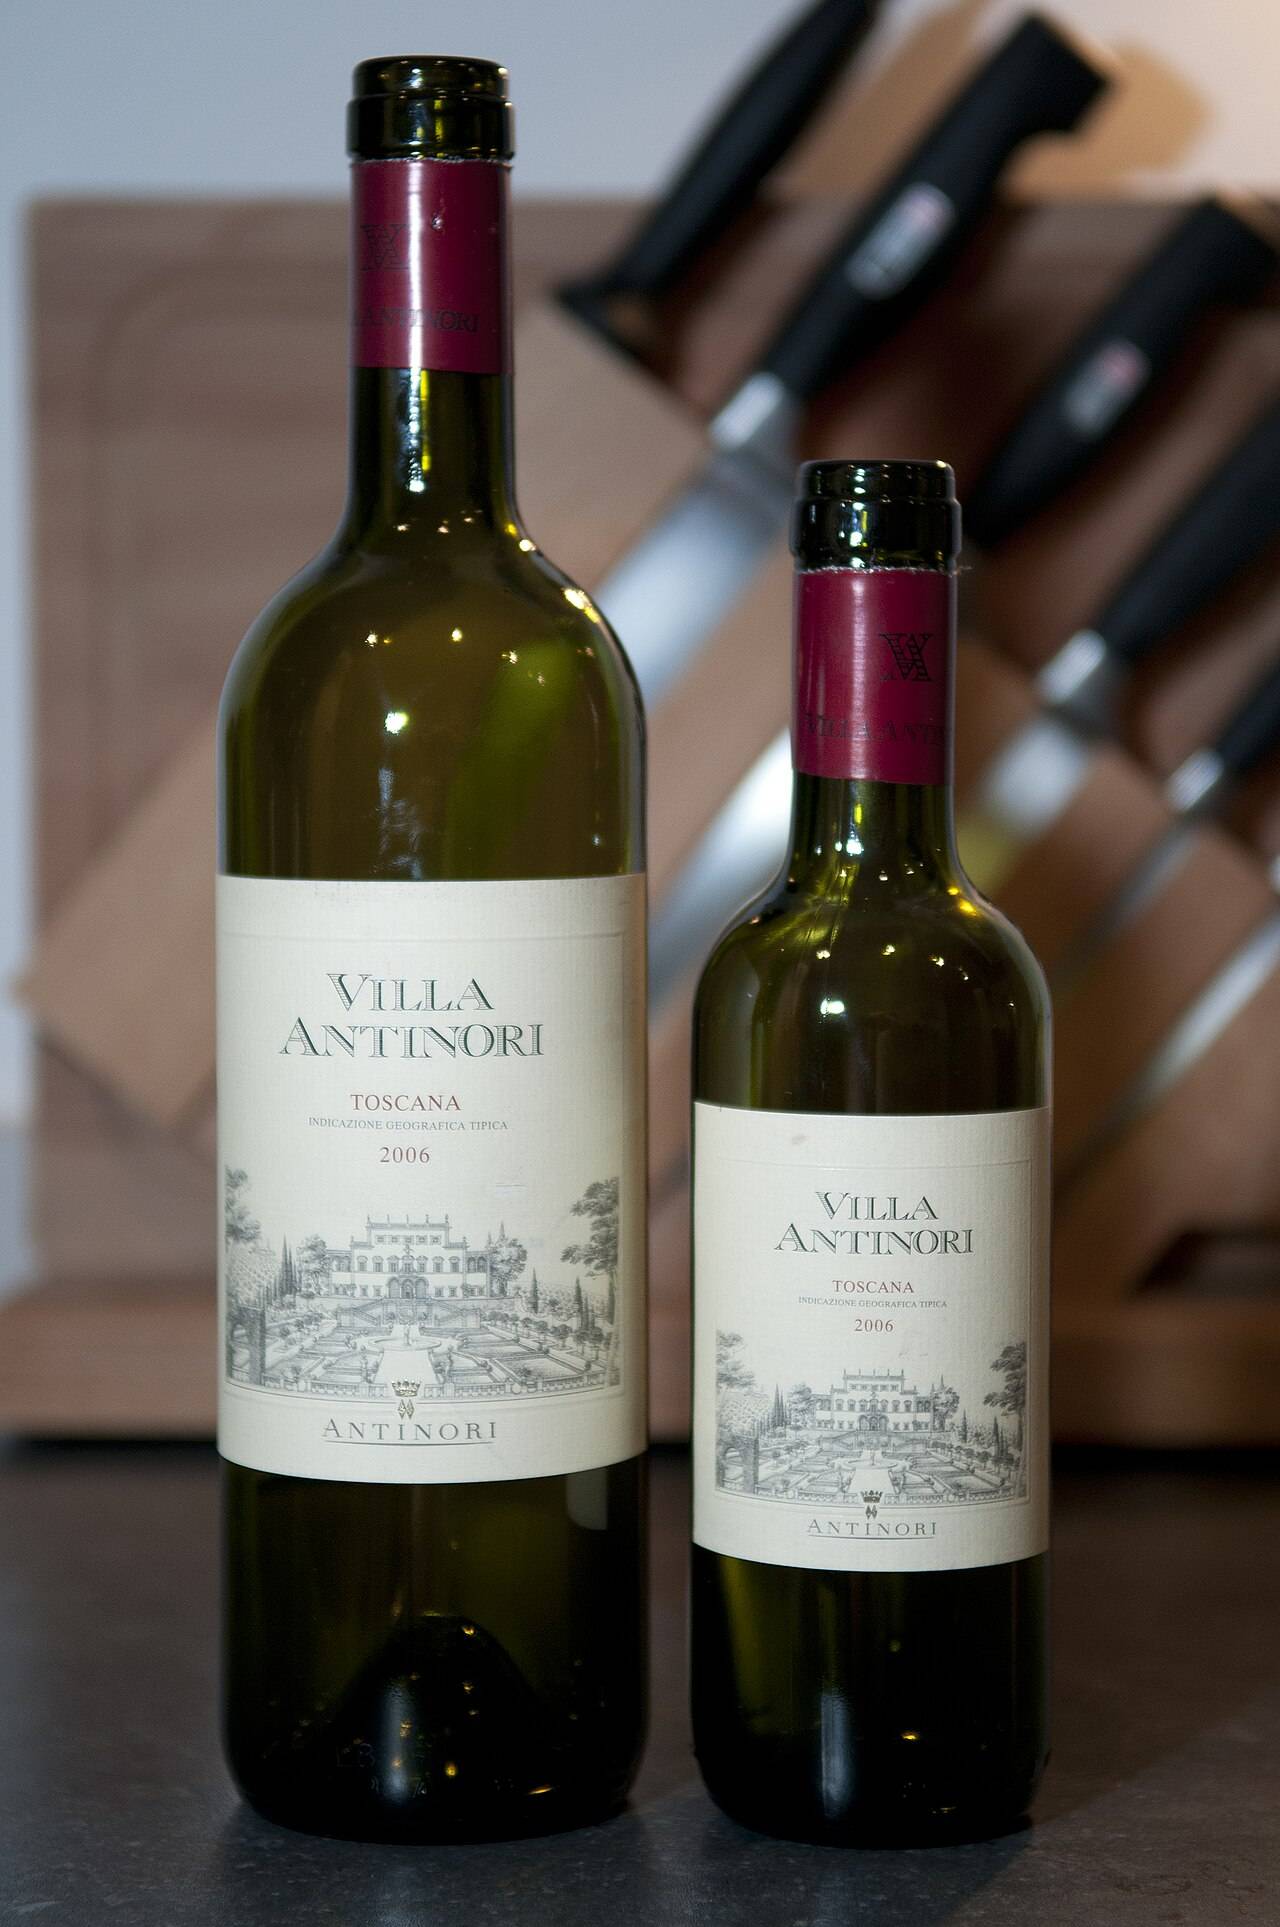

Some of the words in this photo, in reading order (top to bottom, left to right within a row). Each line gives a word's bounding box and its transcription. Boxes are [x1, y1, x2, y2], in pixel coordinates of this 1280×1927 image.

[327, 973, 494, 1011] VILLA
[279, 1016, 544, 1058] ANTINORI
[350, 1094, 461, 1111] TOSCANA
[309, 1117, 383, 1130] INDICAZIONE
[385, 1120, 466, 1131] GEOGRAFICA
[469, 1120, 508, 1130] TIPICA
[379, 1146, 430, 1163] 2006
[816, 1191, 939, 1220] VILLA
[774, 1223, 973, 1254] ANTINORI
[832, 1280, 914, 1293] TOSCANA
[798, 1297, 856, 1307] INDICAZIONE
[858, 1300, 917, 1309] GEOGRAFICA
[919, 1300, 948, 1308] TIPICA
[855, 1319, 893, 1332] 2006
[322, 1418, 497, 1440] ANTINORI
[807, 1519, 938, 1536] ANTINORI
